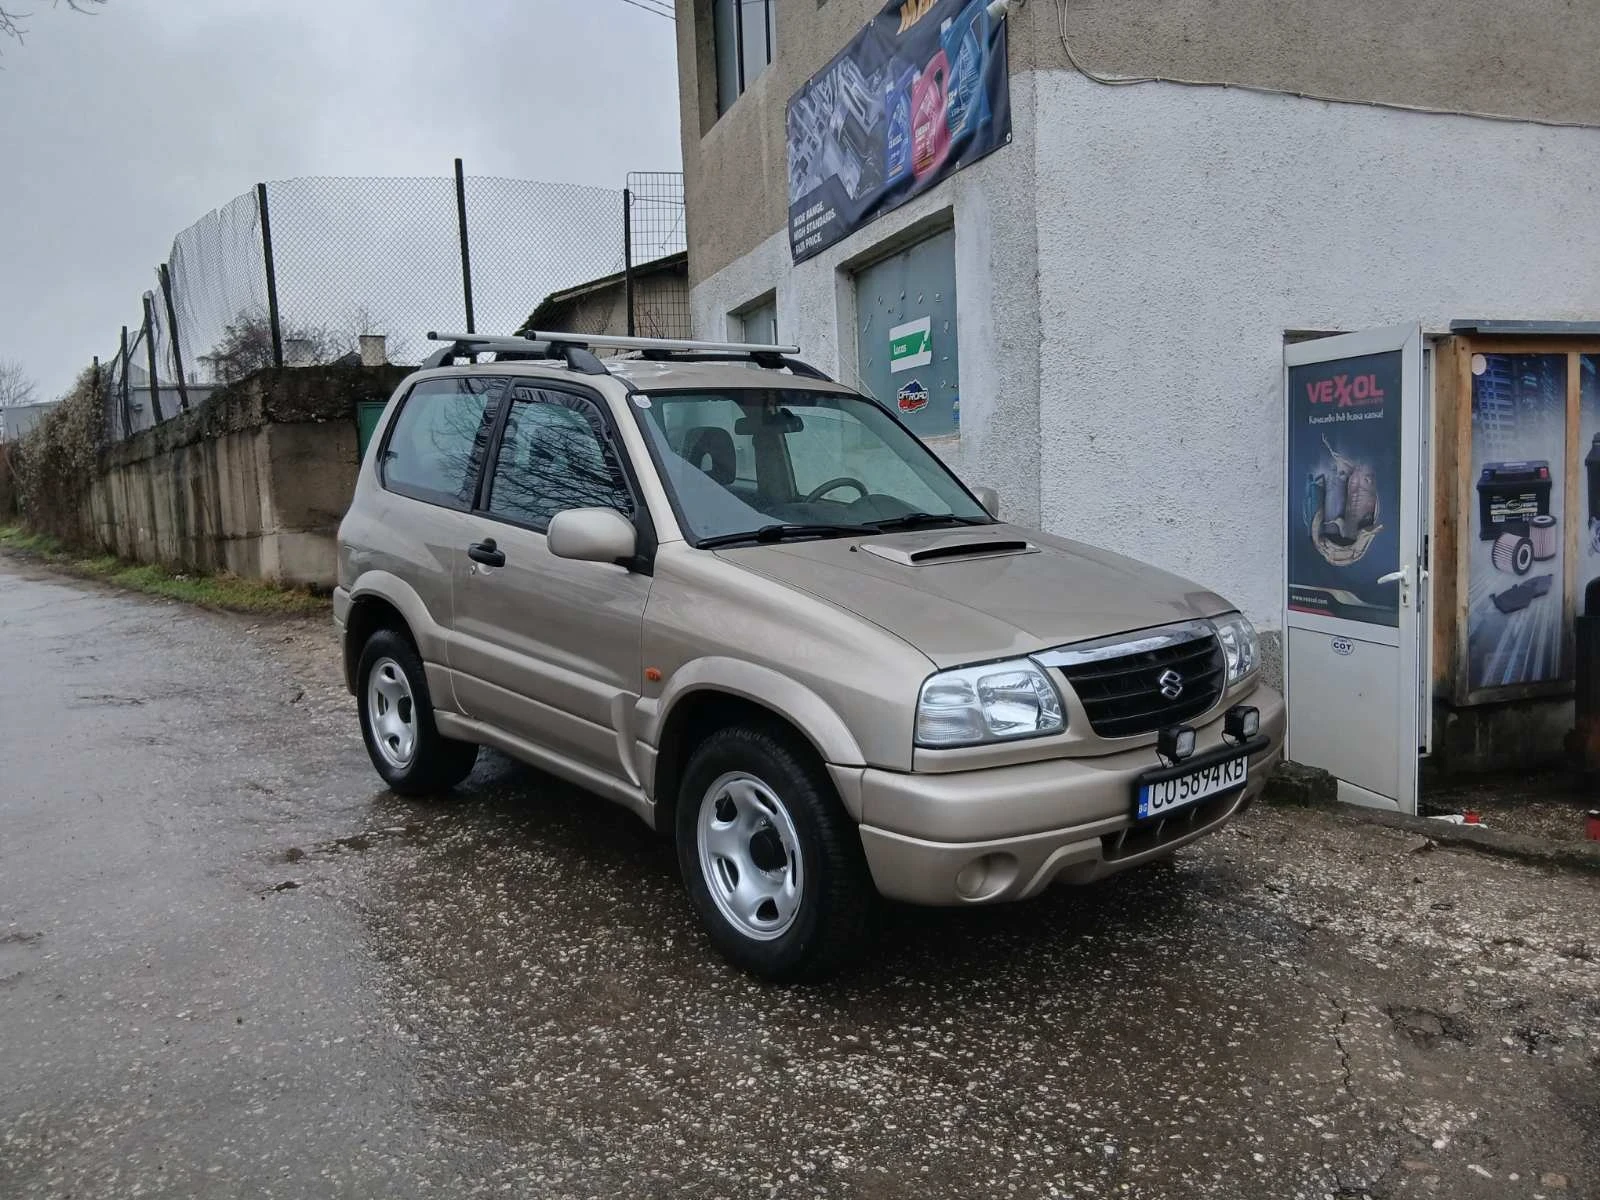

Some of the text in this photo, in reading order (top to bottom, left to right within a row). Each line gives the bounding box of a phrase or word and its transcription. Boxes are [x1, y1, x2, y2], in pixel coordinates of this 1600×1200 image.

[793, 212, 806, 227] WIDE
[793, 227, 806, 241] HIGH
[1138, 803, 1148, 814] BG
